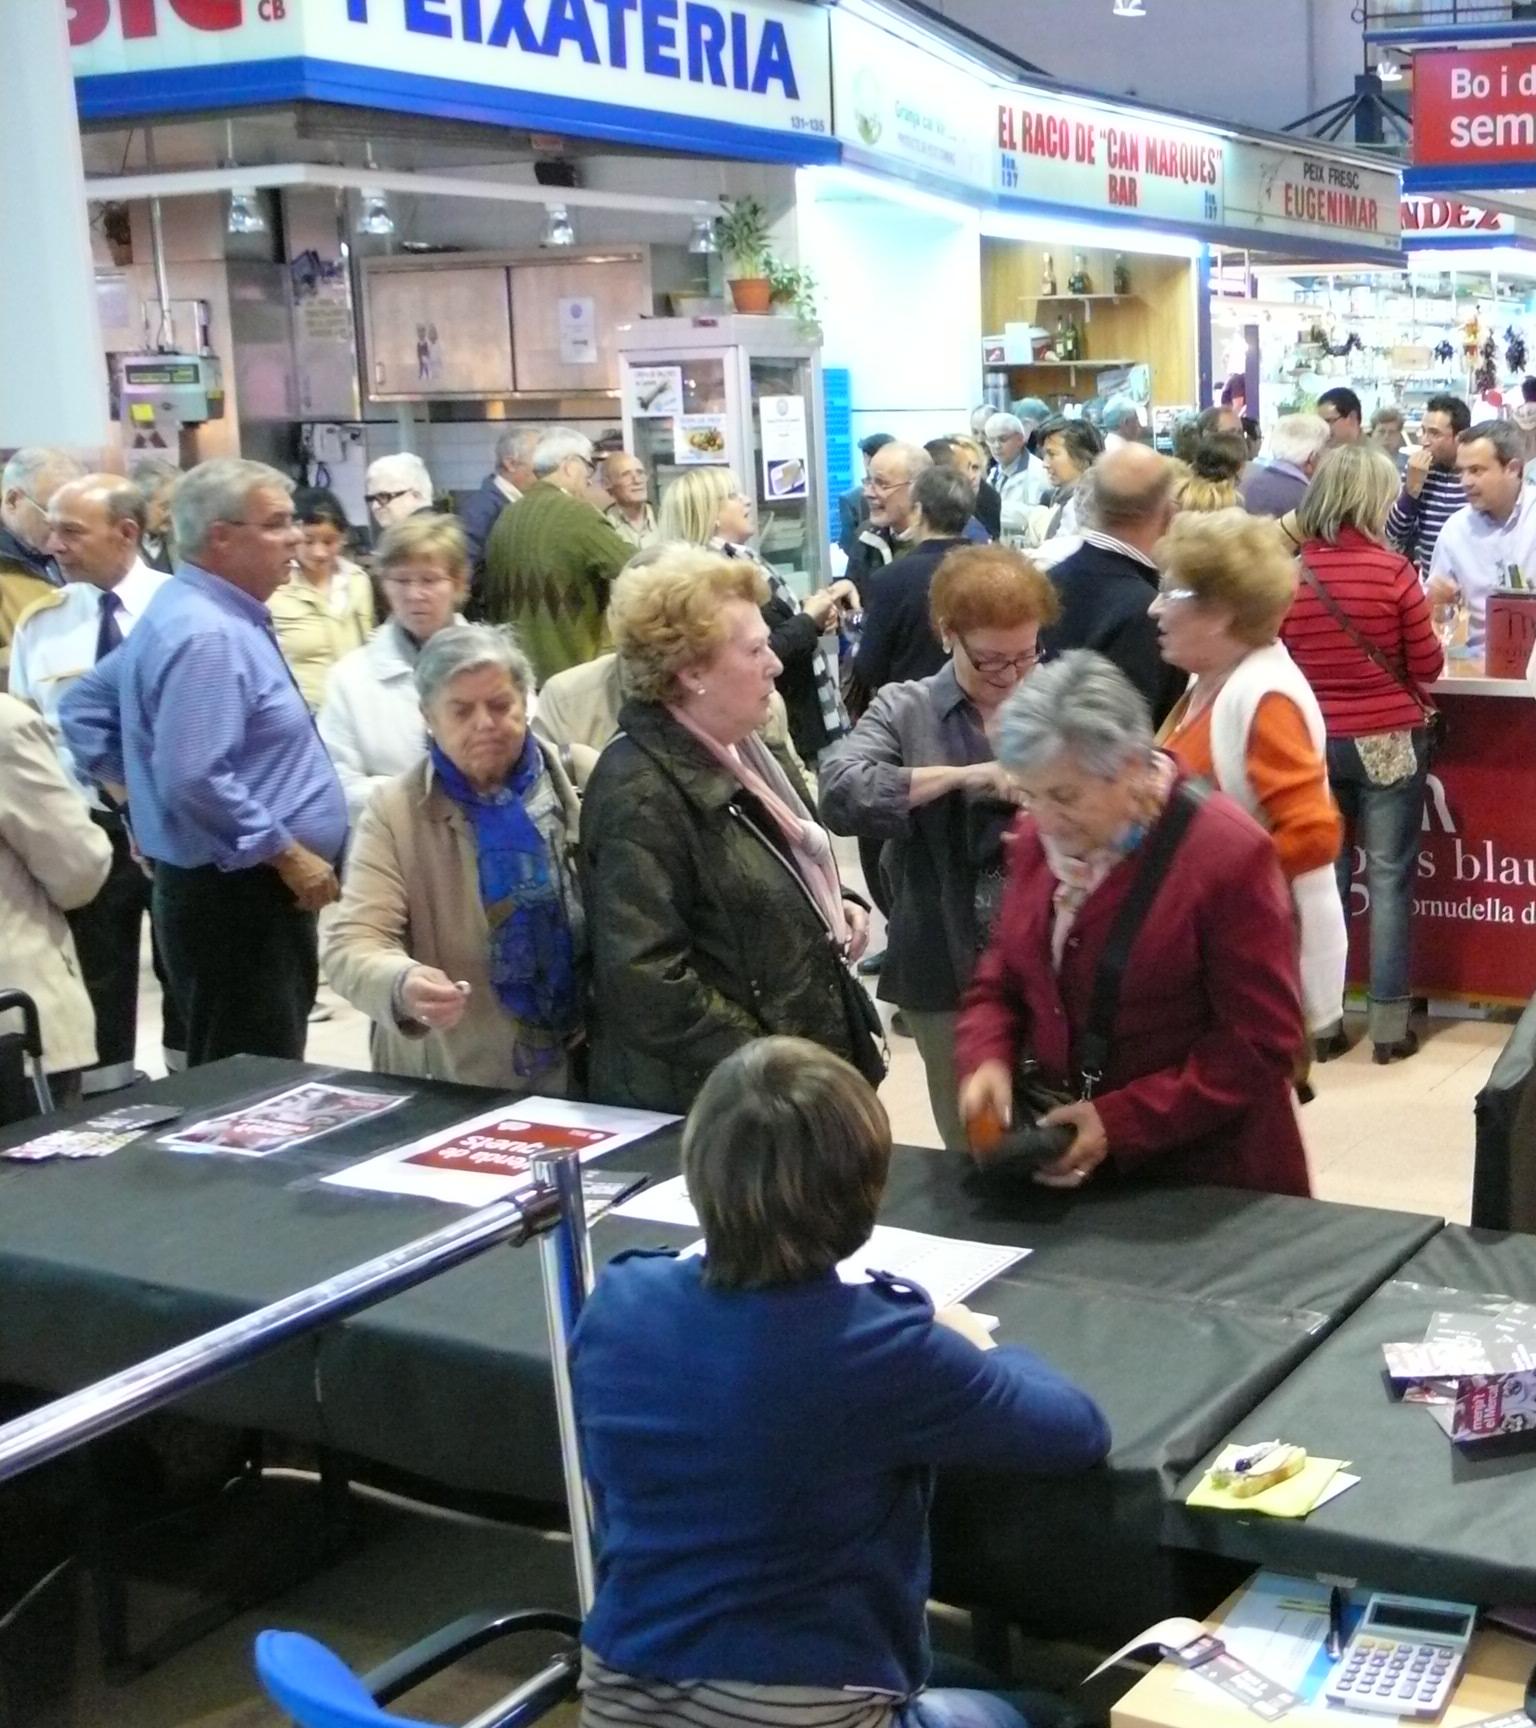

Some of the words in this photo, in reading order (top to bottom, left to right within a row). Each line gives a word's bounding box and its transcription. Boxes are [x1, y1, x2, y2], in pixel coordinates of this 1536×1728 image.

[1451, 68, 1490, 99] Bo
[1501, 66, 1508, 97] i
[999, 105, 1017, 150] EL
[1022, 110, 1070, 161] RACO
[1075, 123, 1095, 165] DE
[1109, 174, 1138, 207] BAR
[1303, 162, 1325, 183] PEIX
[1328, 167, 1360, 190] FRESC
[1284, 183, 1378, 230] EUGENIMAR
